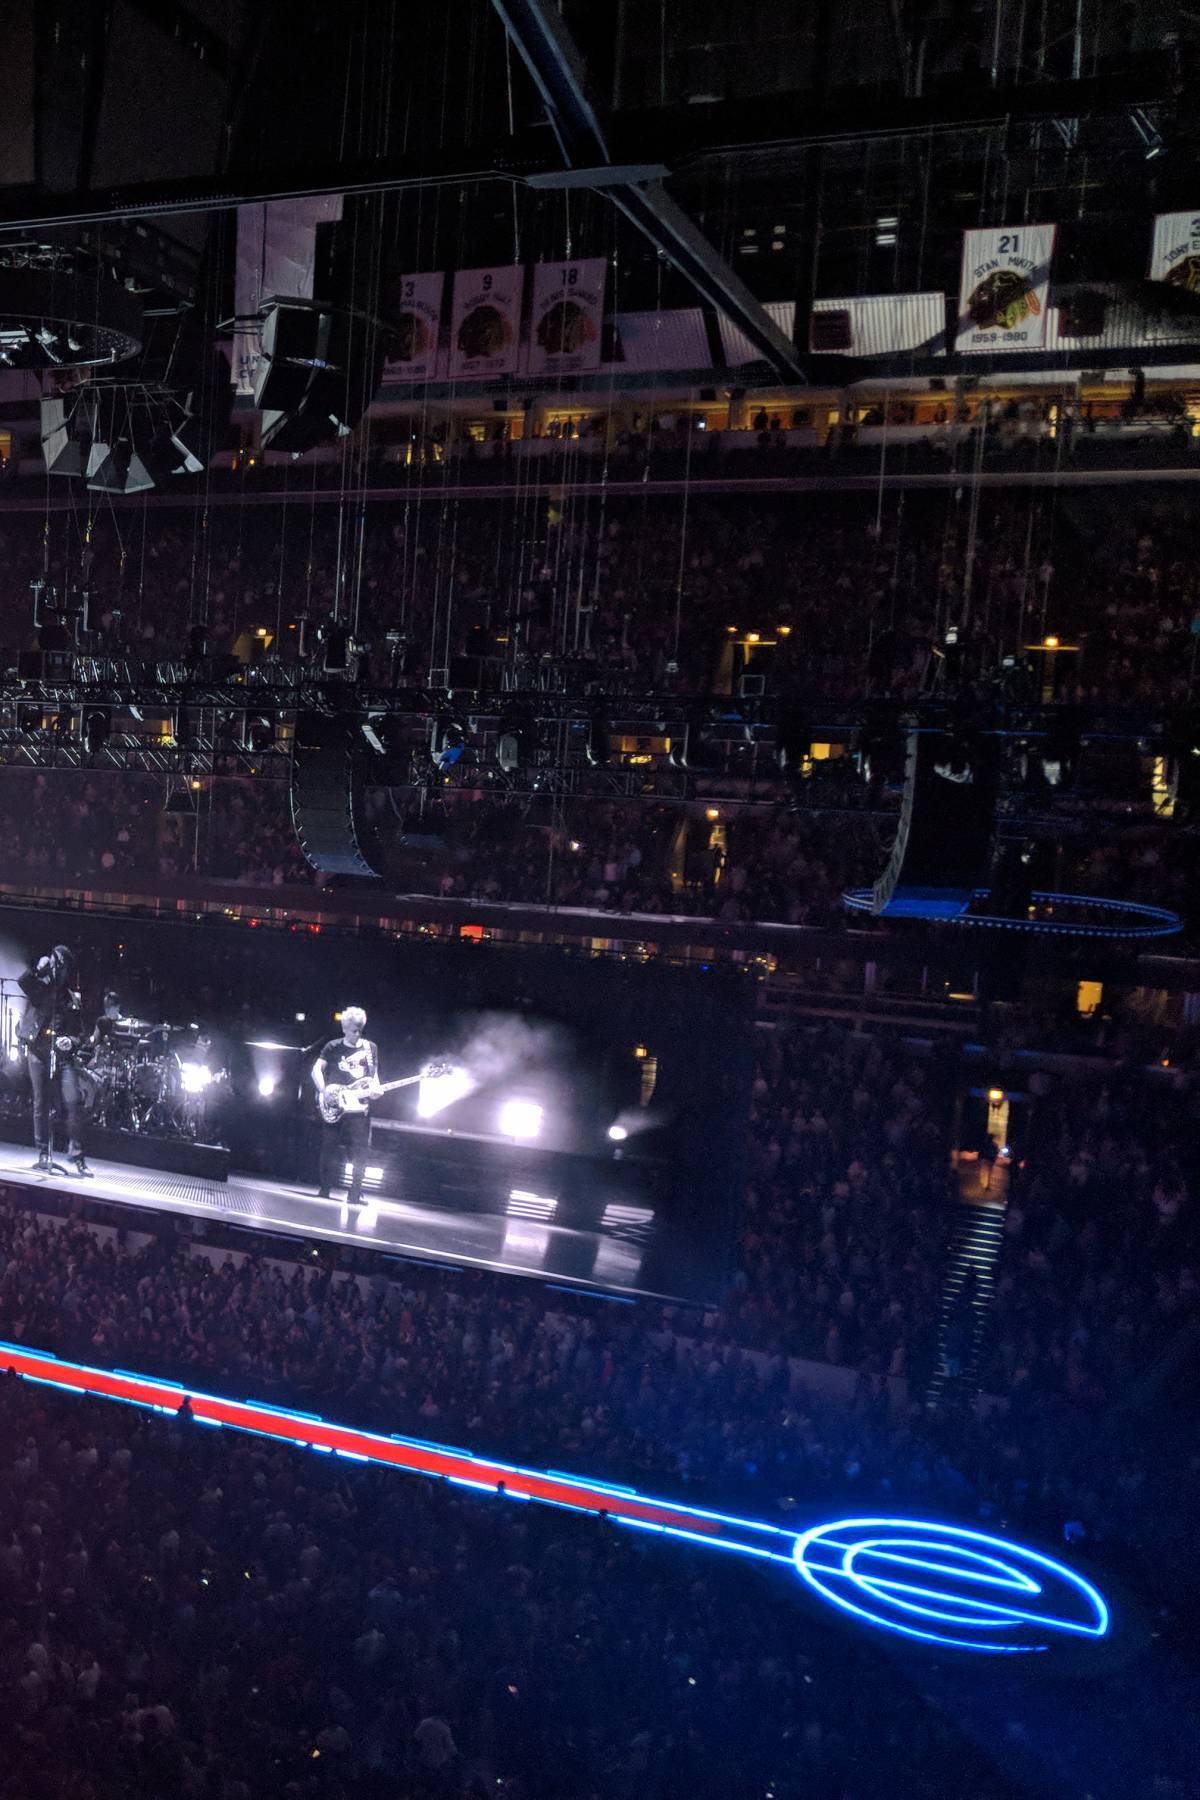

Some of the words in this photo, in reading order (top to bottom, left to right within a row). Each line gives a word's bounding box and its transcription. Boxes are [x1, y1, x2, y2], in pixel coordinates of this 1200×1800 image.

[998, 235, 1019, 254] 21
[974, 258, 999, 278] STAN
[483, 274, 493, 290] 9
[561, 268, 578, 285] 18
[405, 282, 415, 297] 3
[972, 331, 1028, 343] 1959-1980
